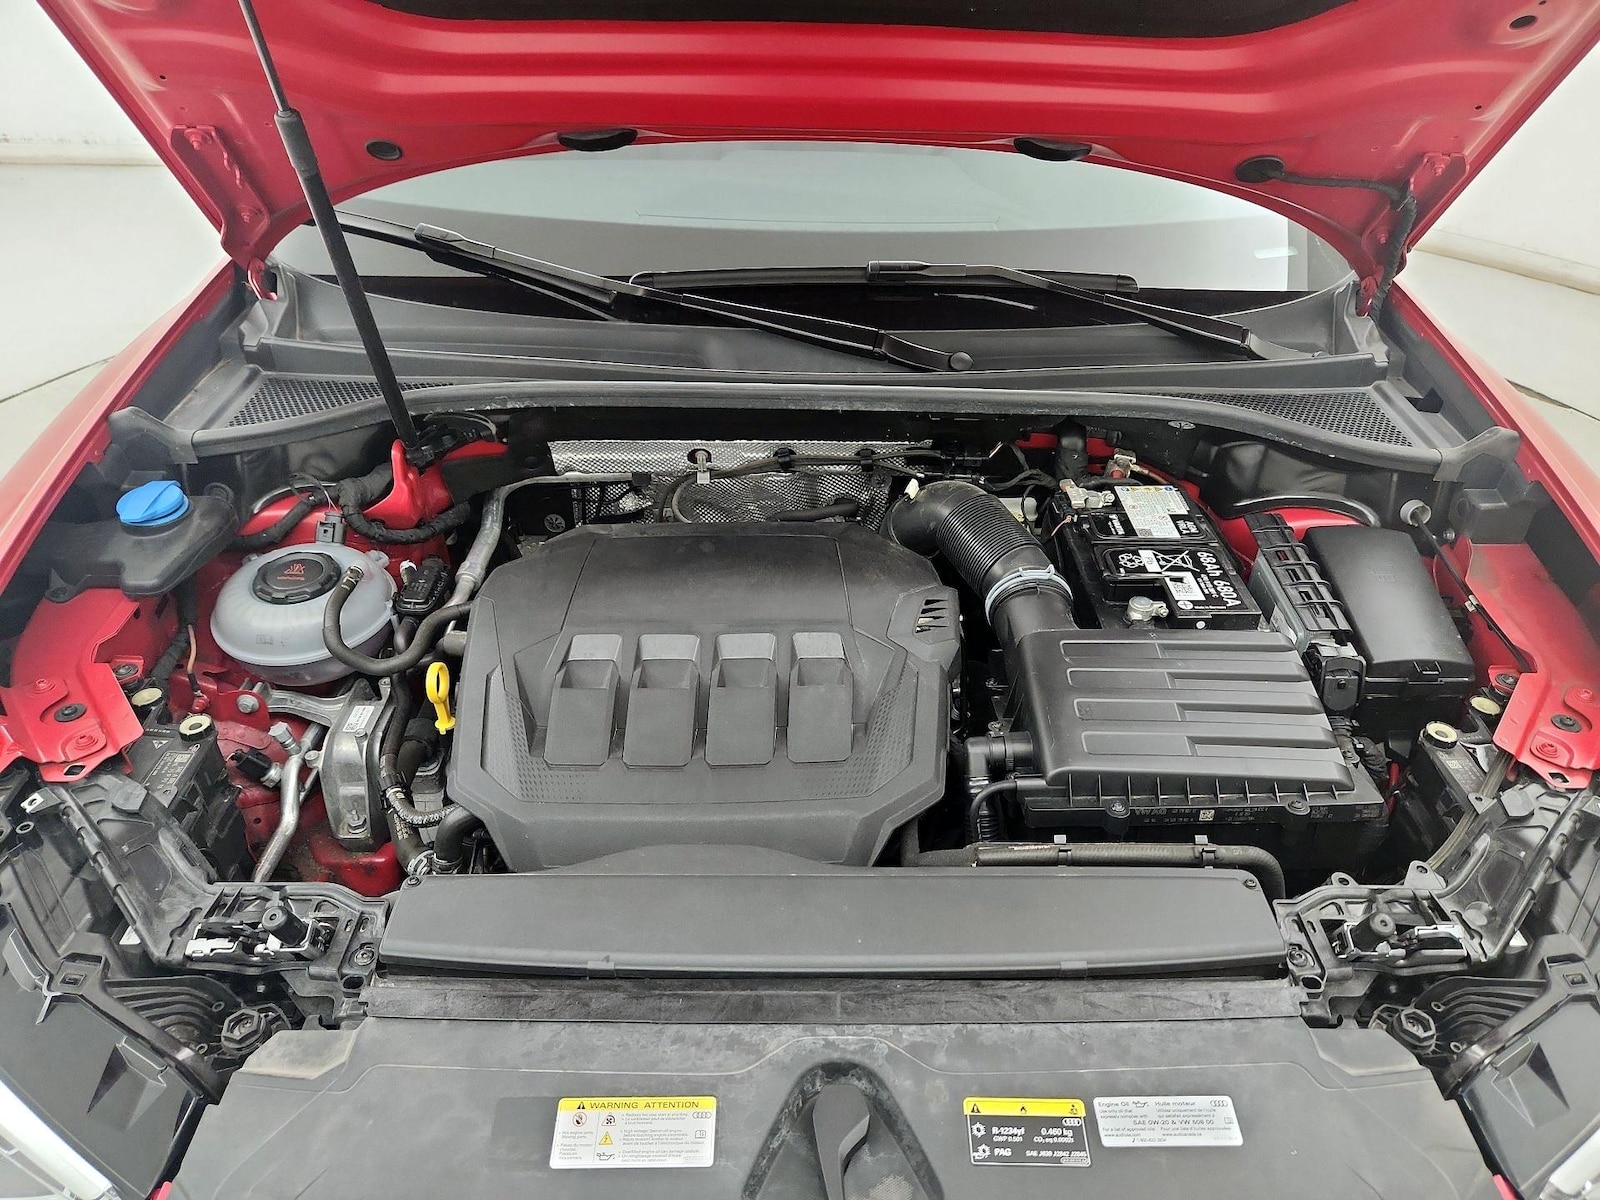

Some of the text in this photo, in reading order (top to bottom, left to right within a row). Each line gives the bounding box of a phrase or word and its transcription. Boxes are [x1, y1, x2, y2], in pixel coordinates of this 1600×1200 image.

[1196, 551, 1223, 577] 68Ah
[1213, 579, 1242, 608] 680A
[644, 1101, 699, 1109] ATTENTION
[992, 1126, 1025, 1136] R-1234yf
[1063, 1128, 1073, 1136] kg
[994, 1148, 1012, 1156] PAG
